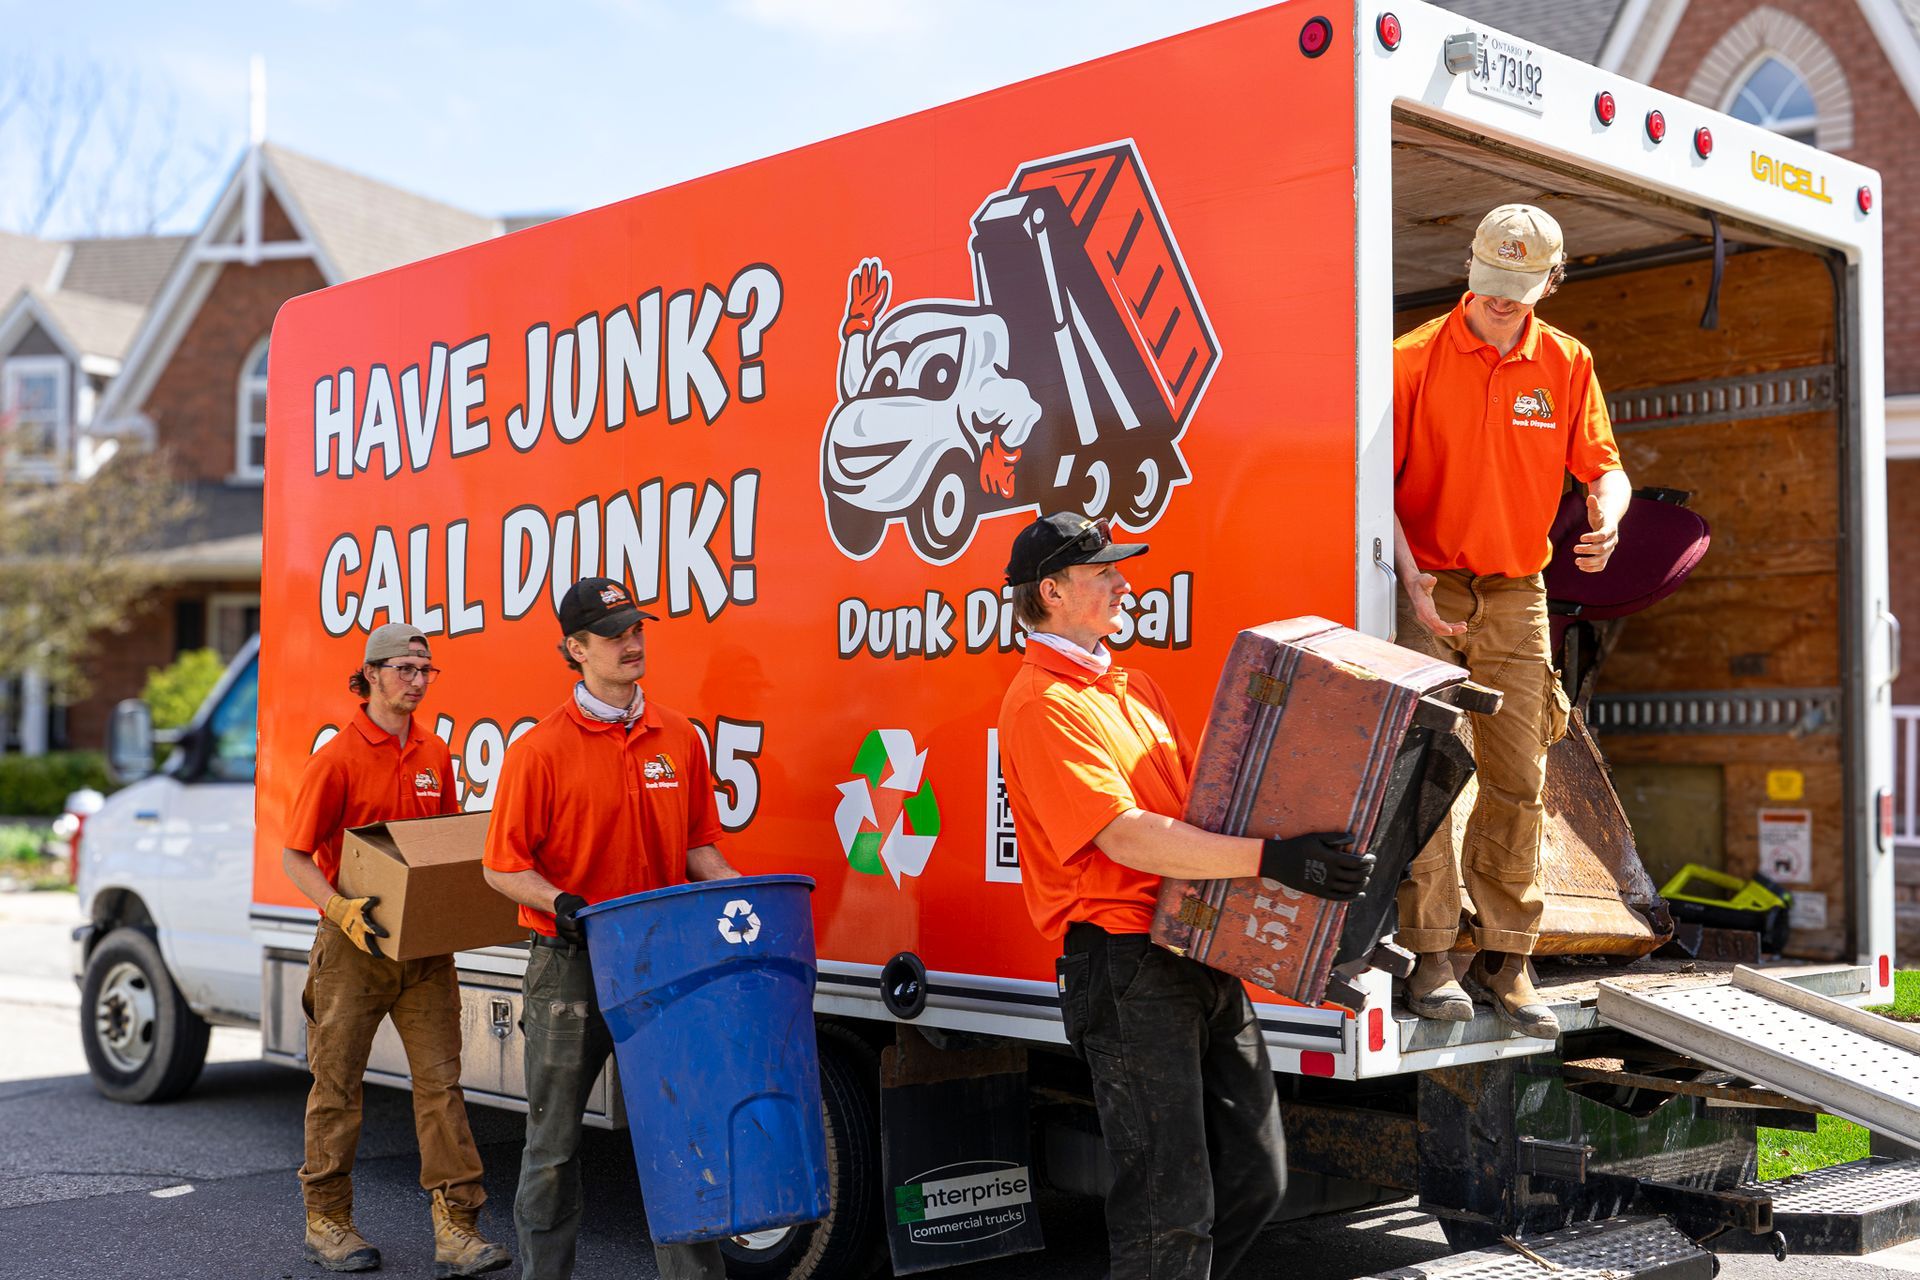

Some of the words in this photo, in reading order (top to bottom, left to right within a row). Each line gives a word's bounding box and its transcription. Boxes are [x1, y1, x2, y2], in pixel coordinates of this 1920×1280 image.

[314, 334, 490, 479] HAVE
[506, 263, 784, 453] JUNK?
[320, 518, 484, 638] CALL
[502, 468, 761, 623] DUNK!
[837, 590, 957, 660] Dunk
[902, 1177, 1028, 1213] enterprise
[913, 1215, 983, 1238] commercial
[984, 1210, 1022, 1226] trucks
